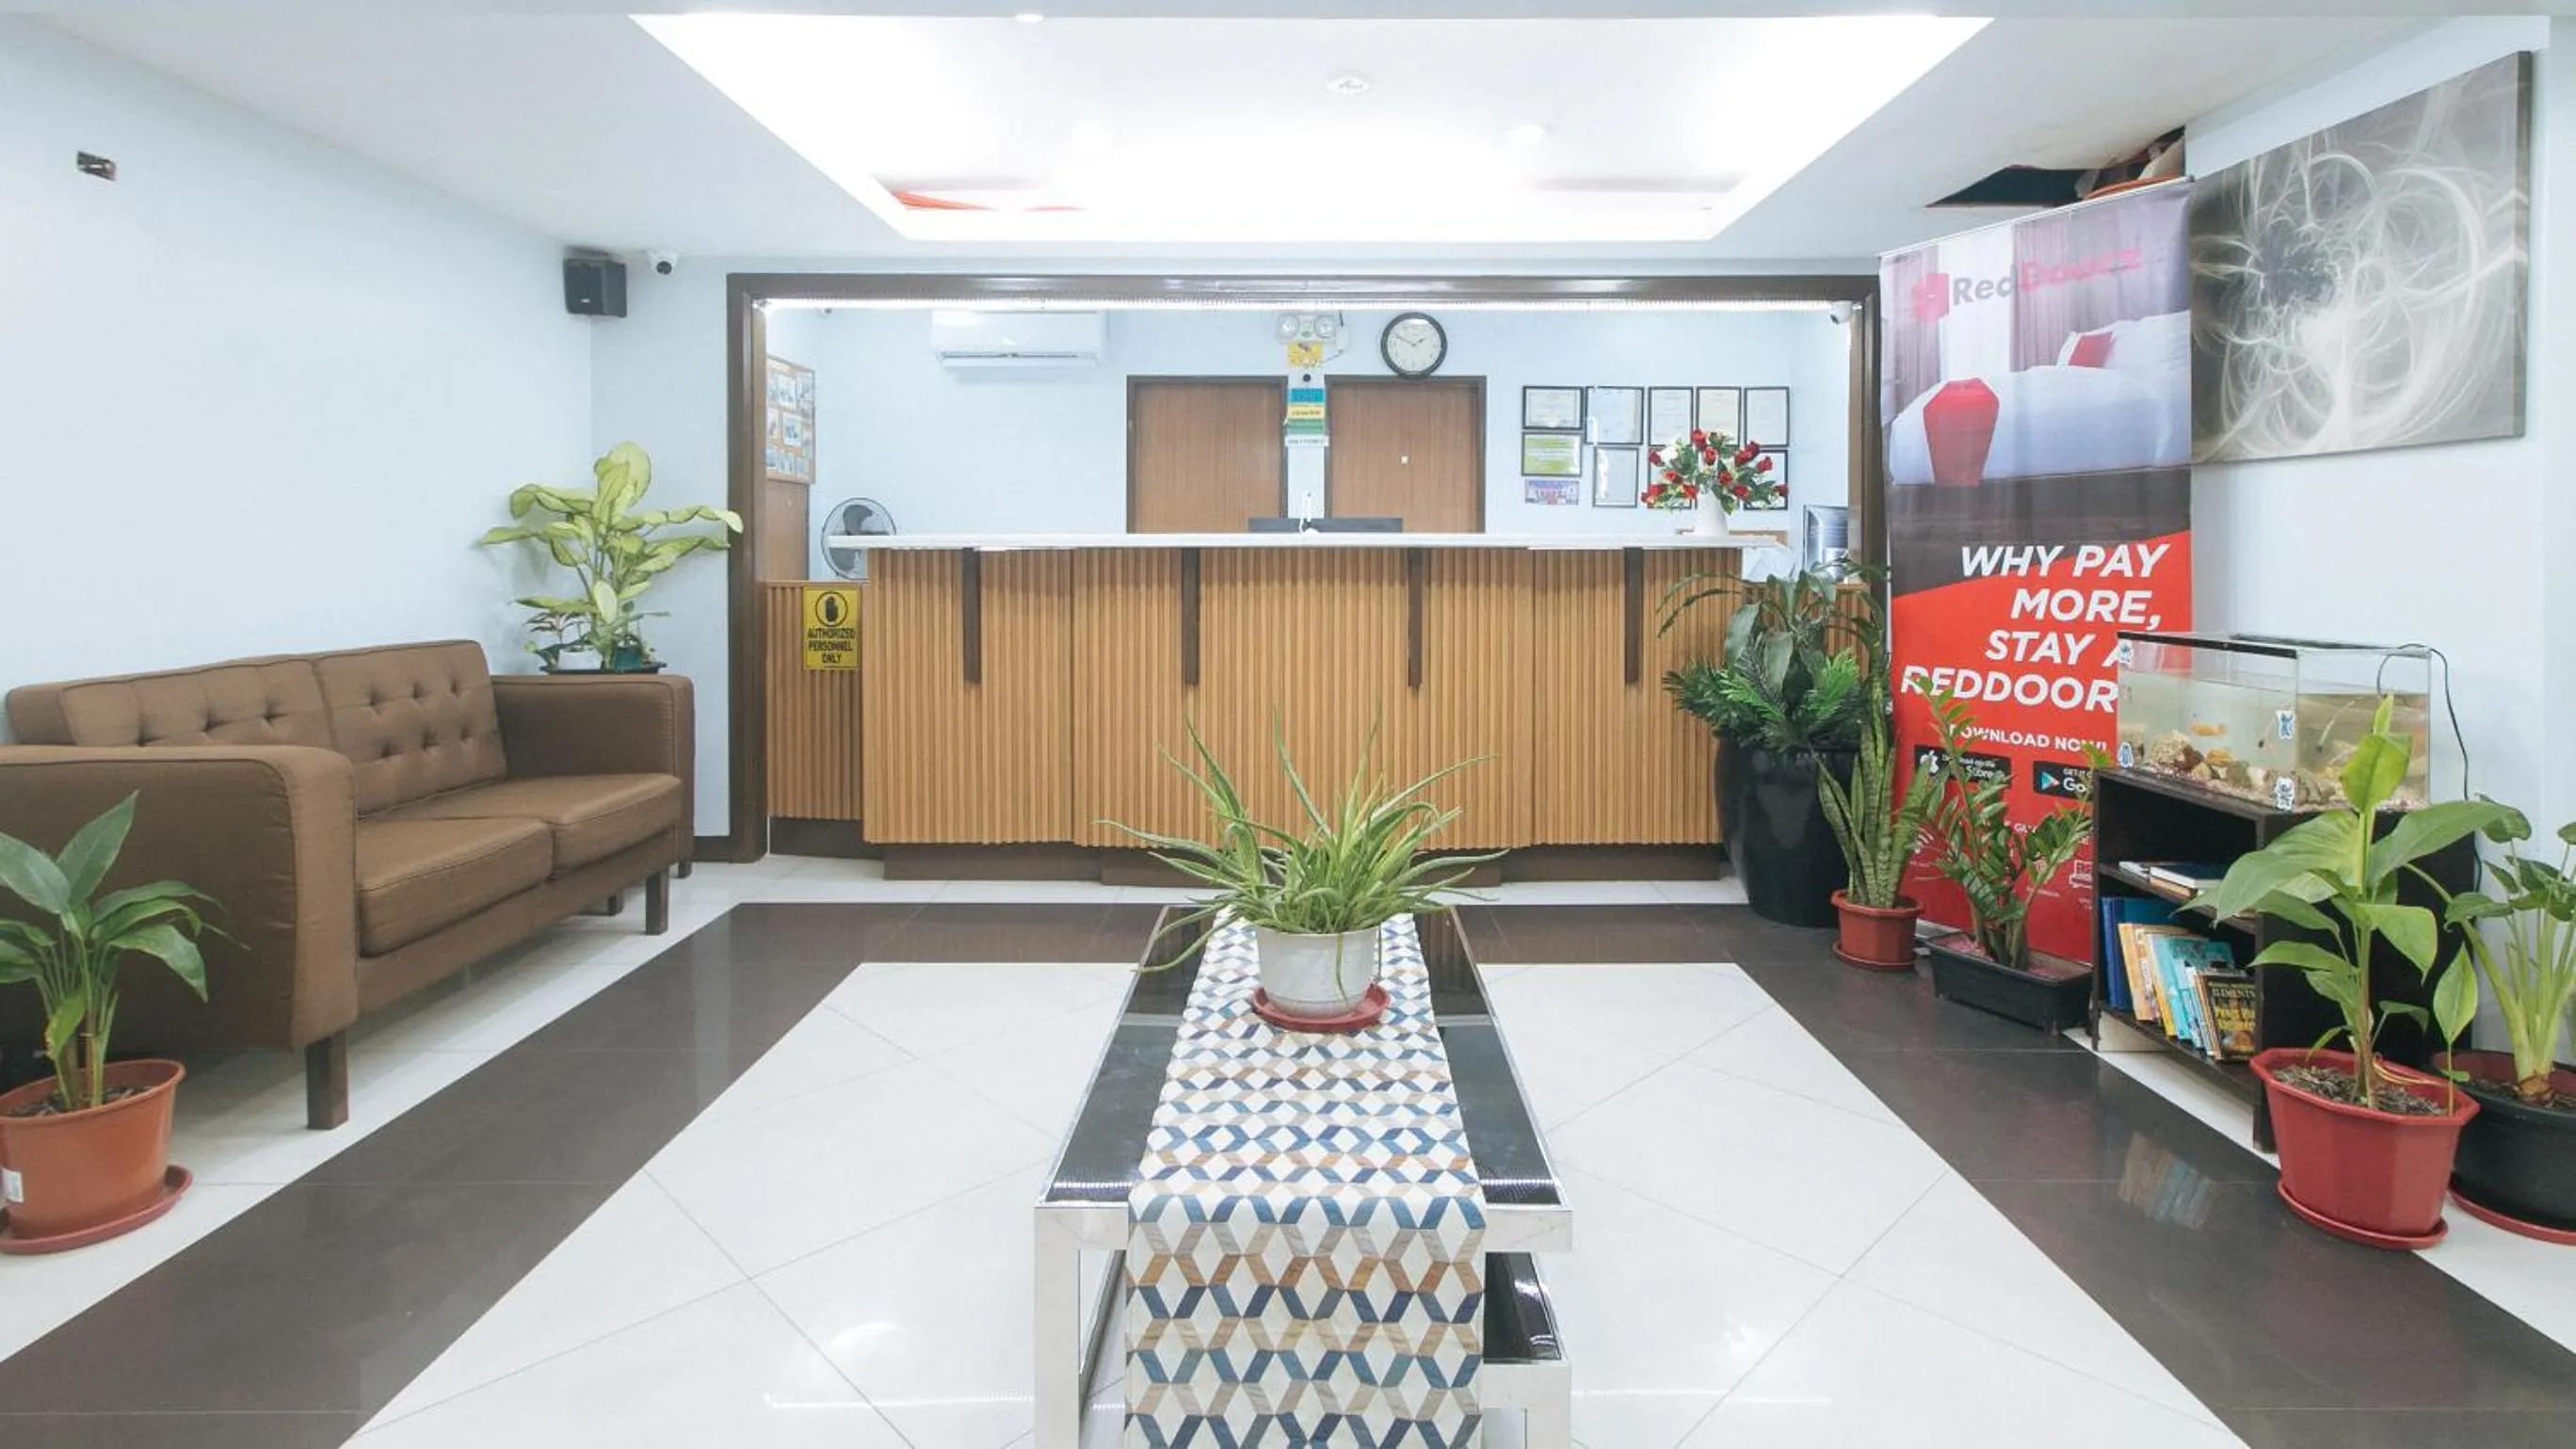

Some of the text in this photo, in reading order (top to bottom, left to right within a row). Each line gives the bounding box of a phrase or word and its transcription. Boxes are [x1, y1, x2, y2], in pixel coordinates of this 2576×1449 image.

[1962, 543, 2170, 578] WHY PAY
[2010, 588, 2162, 631] MORE,
[808, 627, 856, 639] AUTHORIZED
[808, 639, 853, 652] PERSONNEL
[1985, 630, 2096, 666] STAY
[821, 652, 842, 664] ONLY
[1900, 665, 2118, 714] REDDOOR
